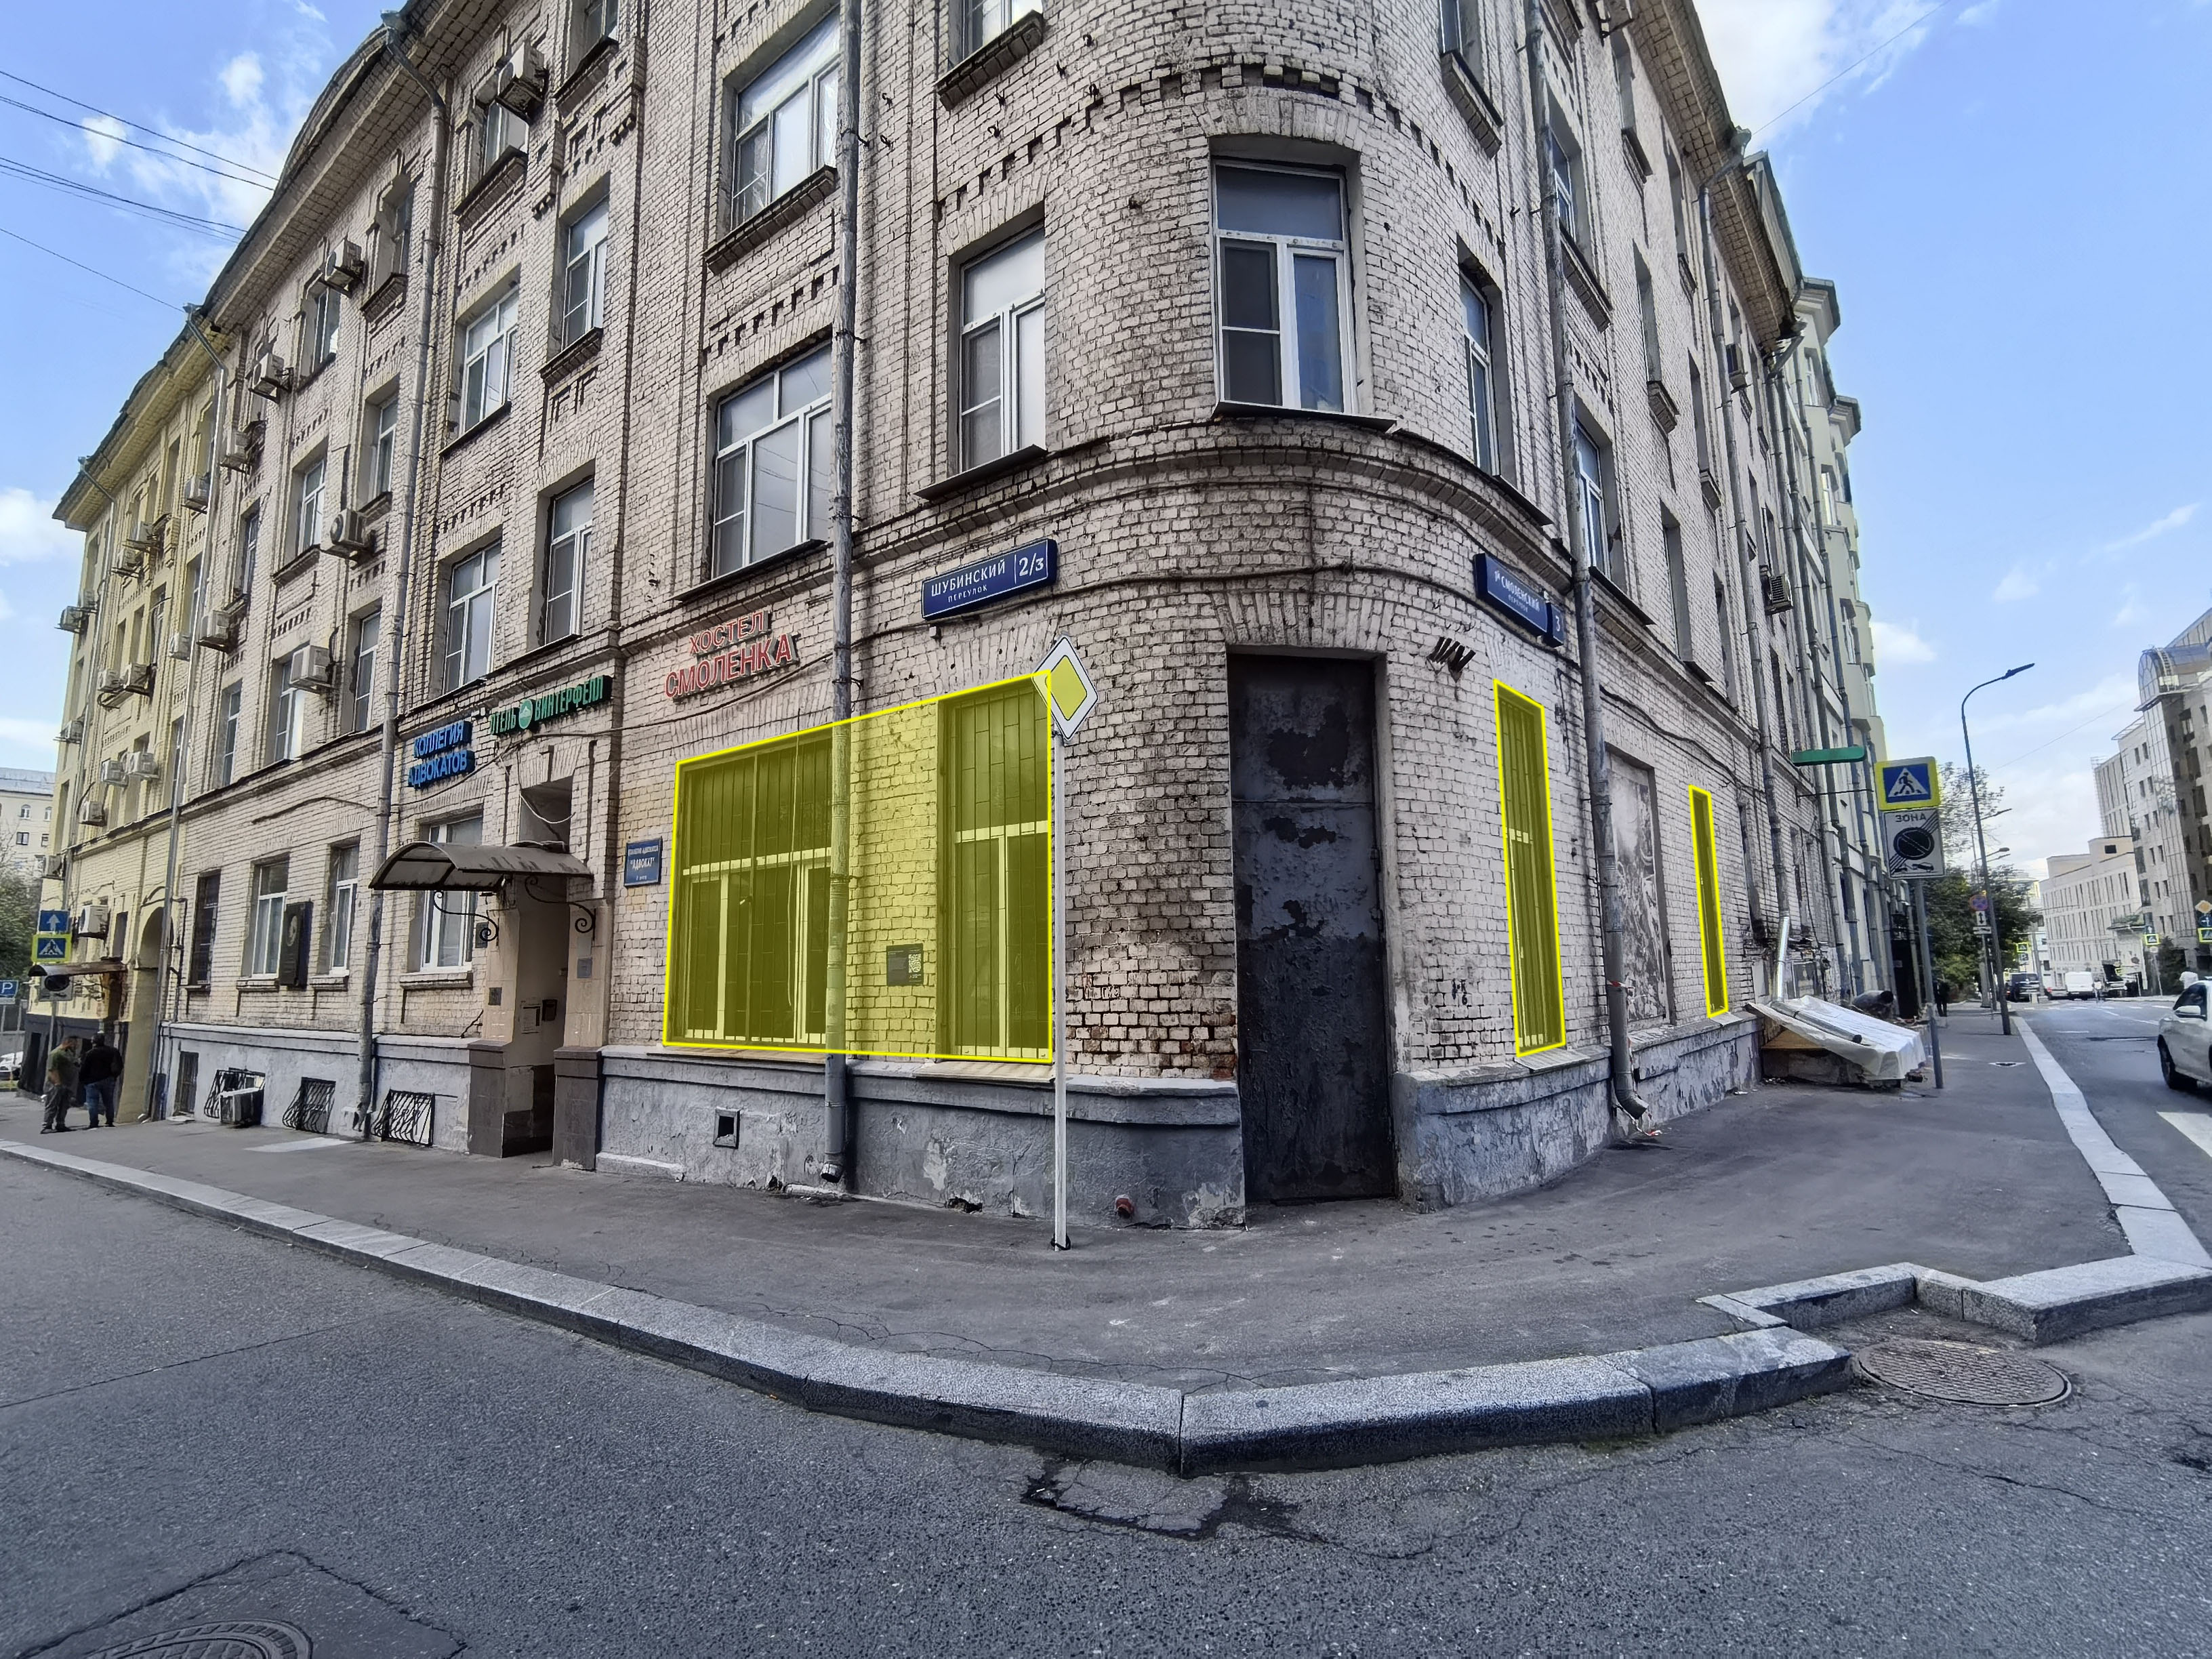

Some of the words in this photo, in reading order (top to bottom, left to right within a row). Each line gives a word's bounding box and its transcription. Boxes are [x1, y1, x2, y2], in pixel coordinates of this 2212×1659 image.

[931, 558, 1006, 597] ШУБИНСКИЙ
[1019, 552, 1044, 577] 2/3
[947, 584, 988, 603] ПЕРЕУЛОК
[689, 611, 764, 654] ХОСТЕЛ
[665, 633, 792, 698] СМОЛЕНКА
[489, 709, 516, 735] ОТЕЛЬ
[534, 676, 604, 722] ВИНТЕРФЕЛЛ
[413, 720, 464, 758] КОЛЛЕГИЯ
[408, 749, 468, 787] АДВОКАТОВ
[1895, 813, 1927, 823] ЗОНА
